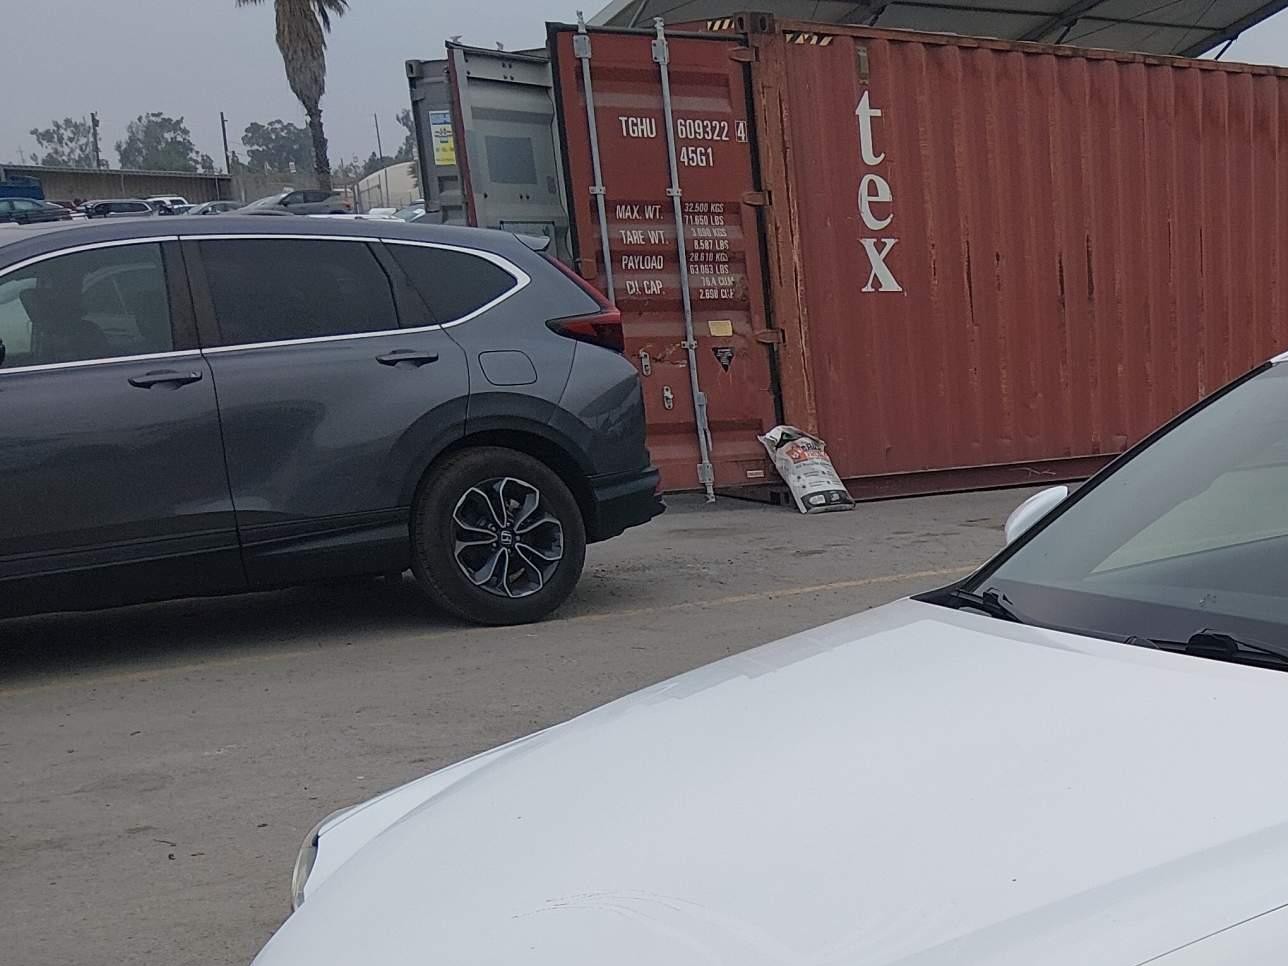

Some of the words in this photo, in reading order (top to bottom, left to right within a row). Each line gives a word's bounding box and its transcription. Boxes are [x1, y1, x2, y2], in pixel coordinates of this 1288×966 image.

[618, 116, 657, 138] TGHU
[677, 119, 729, 141] 609322
[736, 121, 747, 142] 4
[680, 147, 714, 167] 45G1
[855, 90, 903, 292] tex
[644, 205, 664, 220] WT.
[710, 203, 725, 213] KGS
[710, 215, 725, 226] LBS
[619, 230, 646, 245] TARE
[647, 230, 669, 245] WT.
[715, 239, 729, 250] LBS
[622, 255, 664, 270] PAYLOAD
[715, 263, 729, 274] LBS
[643, 280, 666, 295] CAP.
